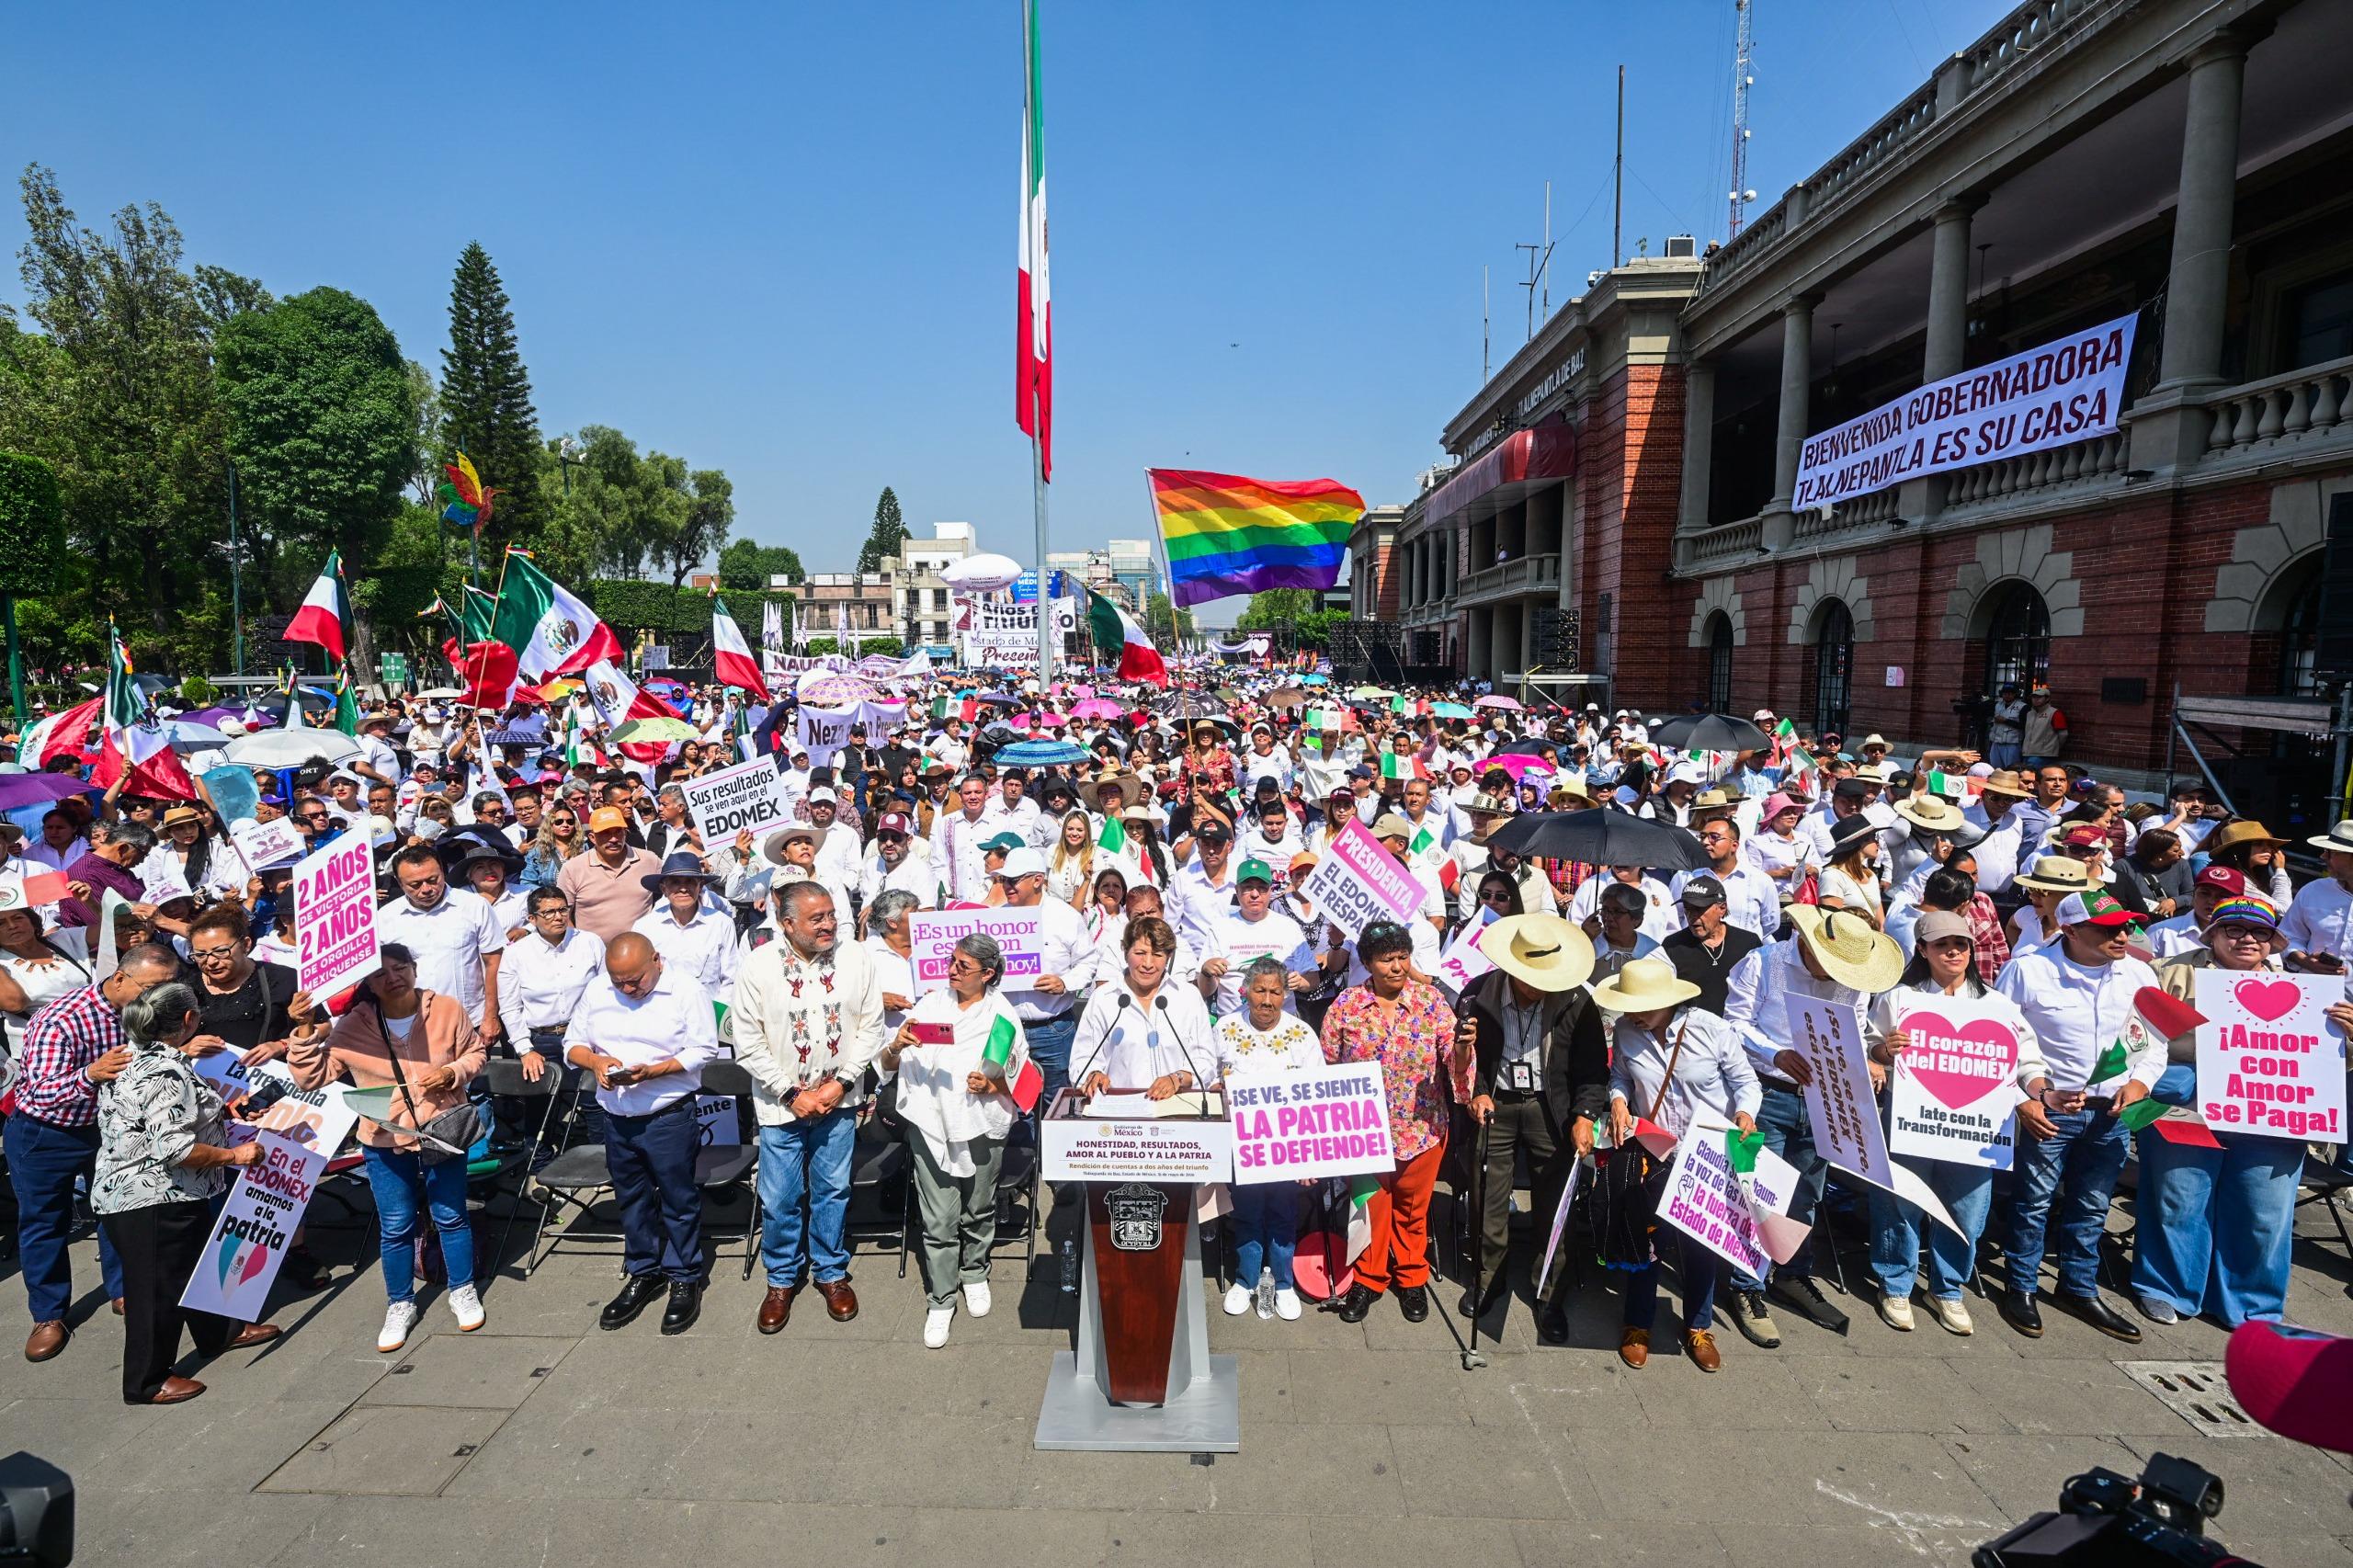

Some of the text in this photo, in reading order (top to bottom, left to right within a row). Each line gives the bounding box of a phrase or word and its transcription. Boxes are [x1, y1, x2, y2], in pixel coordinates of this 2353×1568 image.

[1802, 328, 2124, 471] BIENVENIDA GOBERNADORA
[1796, 387, 2108, 506] TLALNEPANTLA ES SU CASA
[689, 768, 774, 807] Sus resultados
[705, 805, 713, 814] se
[715, 800, 730, 811] ven
[749, 790, 759, 800] en
[760, 785, 767, 796] el
[704, 797, 781, 837] EDOMÉX
[298, 842, 368, 911] 2 AÑOS
[1324, 861, 1342, 885] EL
[1338, 828, 1415, 915] PRESIDENTA,
[300, 881, 368, 926] DE VICTORIA,
[1308, 874, 1367, 937] TE RESPA
[301, 895, 372, 964] 2 AÑOS
[914, 919, 1037, 945] ¡Es un honor
[998, 938, 1022, 951] on
[303, 947, 372, 992] MEXIQUENSE
[304, 934, 369, 980] DE ORGULLO
[1006, 956, 1039, 974] hoy!
[1804, 1011, 1819, 1054] está
[1909, 1029, 2008, 1060] El corazón
[2220, 1024, 2319, 1053] ¡Amor
[225, 1060, 247, 1080] La
[1824, 1006, 1841, 1040] ¡Se
[1842, 1078, 1854, 1102] se
[1906, 1051, 2011, 1082] del EDOMÉX
[2240, 1055, 2299, 1078] con
[1233, 1076, 1379, 1107] ¡SE VE, SE SIENTE,
[1820, 1033, 1853, 1142] el EDOMÉX
[2225, 1074, 2314, 1104] Amor
[1235, 1098, 1382, 1141] LA PATRIA
[1897, 1117, 2012, 1146] Transformación
[1920, 1106, 1992, 1129] late con la
[2205, 1100, 2338, 1136] se Paga!
[267, 1146, 306, 1173] En el
[1076, 1141, 1201, 1150] HONESTIDAD, RESULTADOS,
[1239, 1131, 1388, 1168] SE DEFIENDE!
[1696, 1139, 1729, 1174] Claudia
[244, 1165, 311, 1204] EDOMÉX,
[1684, 1153, 1694, 1172] la
[1695, 1161, 1711, 1184] voz
[1711, 1170, 1724, 1192] de
[1723, 1182, 1738, 1204] las
[244, 1186, 294, 1212] amamos
[255, 1206, 276, 1221] a la
[1692, 1184, 1703, 1207] la
[1705, 1191, 1740, 1230] fuerza
[216, 1213, 287, 1251] patria
[1668, 1195, 1708, 1236] Estado
[1708, 1221, 1722, 1246] de
[1722, 1236, 1761, 1271] México
